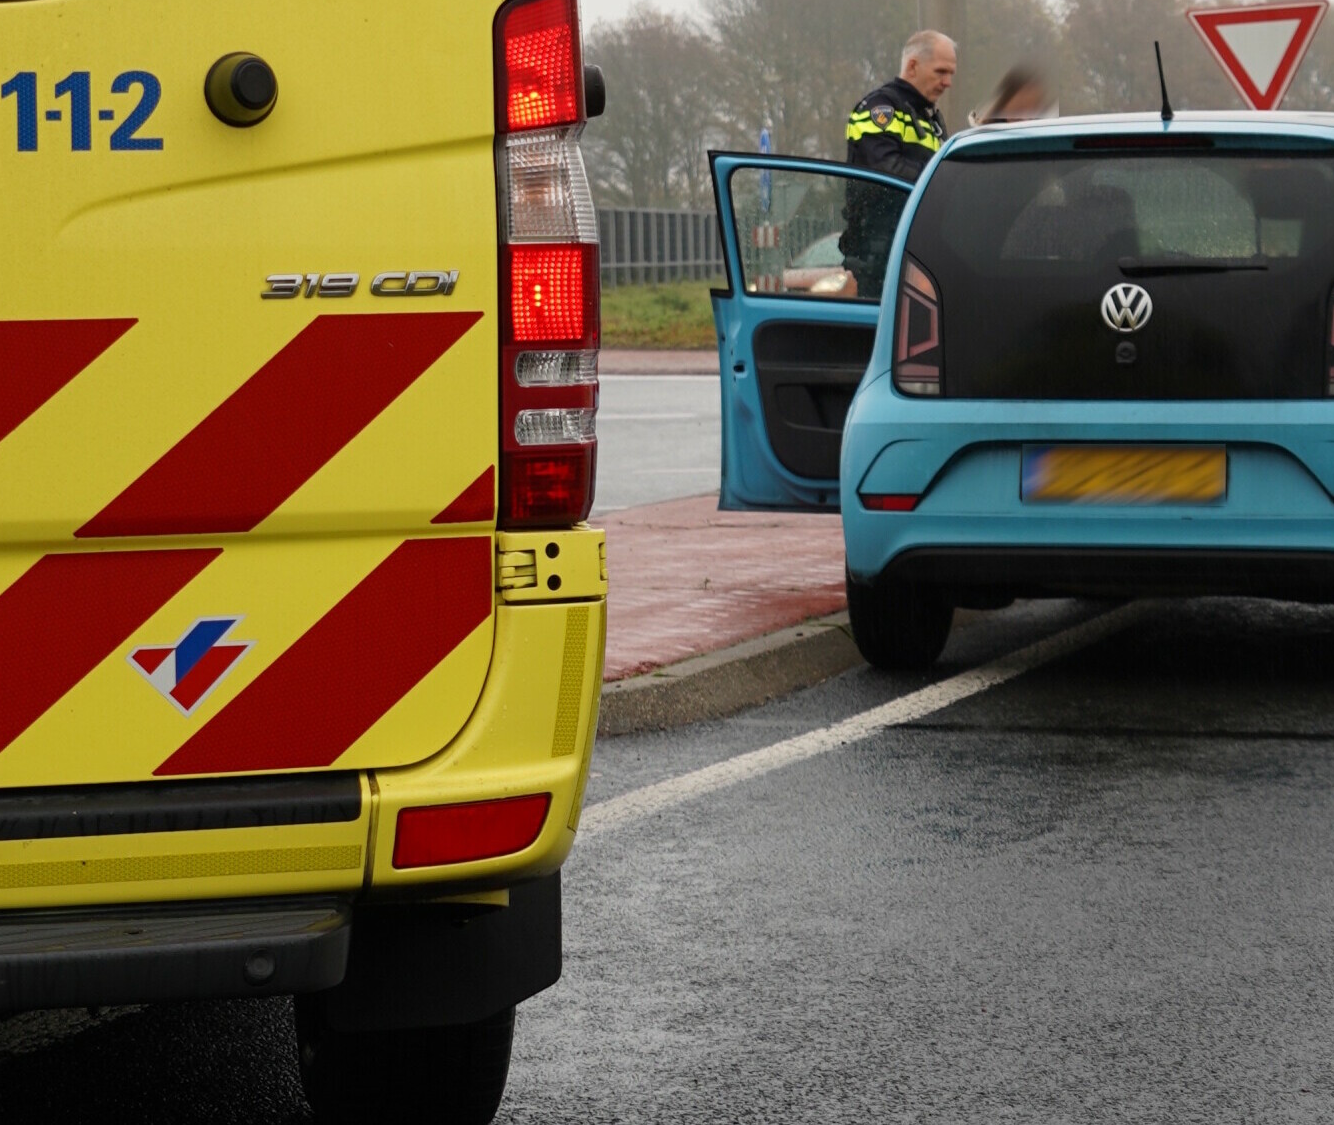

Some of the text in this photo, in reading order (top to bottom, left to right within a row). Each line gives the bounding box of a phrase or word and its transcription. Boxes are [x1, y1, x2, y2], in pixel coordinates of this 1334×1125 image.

[0, 70, 164, 152] 1-1-2
[260, 269, 460, 300] 319 CDI
